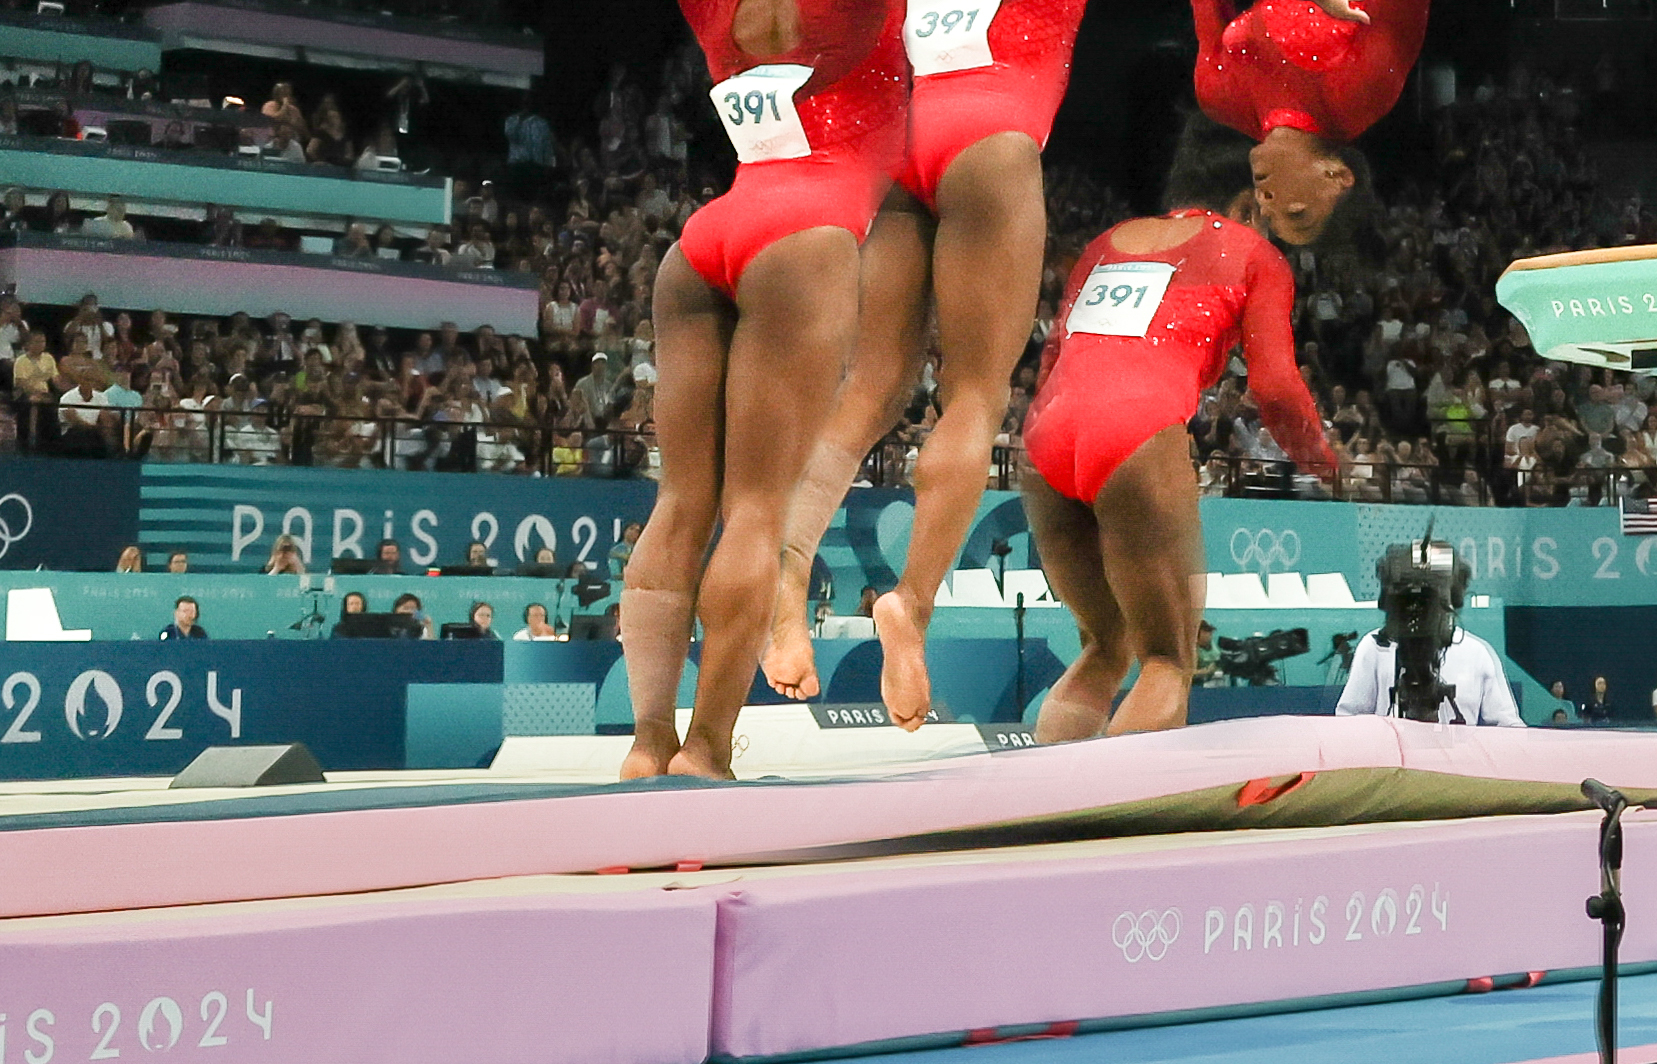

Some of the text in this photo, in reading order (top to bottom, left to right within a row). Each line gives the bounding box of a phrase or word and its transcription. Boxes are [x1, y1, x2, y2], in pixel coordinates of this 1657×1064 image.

[916, 8, 980, 38] 391
[724, 89, 781, 126] 391
[1085, 284, 1149, 309] 391
[470, 511, 622, 571] 202
[1, 669, 242, 743] 2024
[1345, 882, 1451, 941] 2024
[89, 988, 273, 1060] 2024
